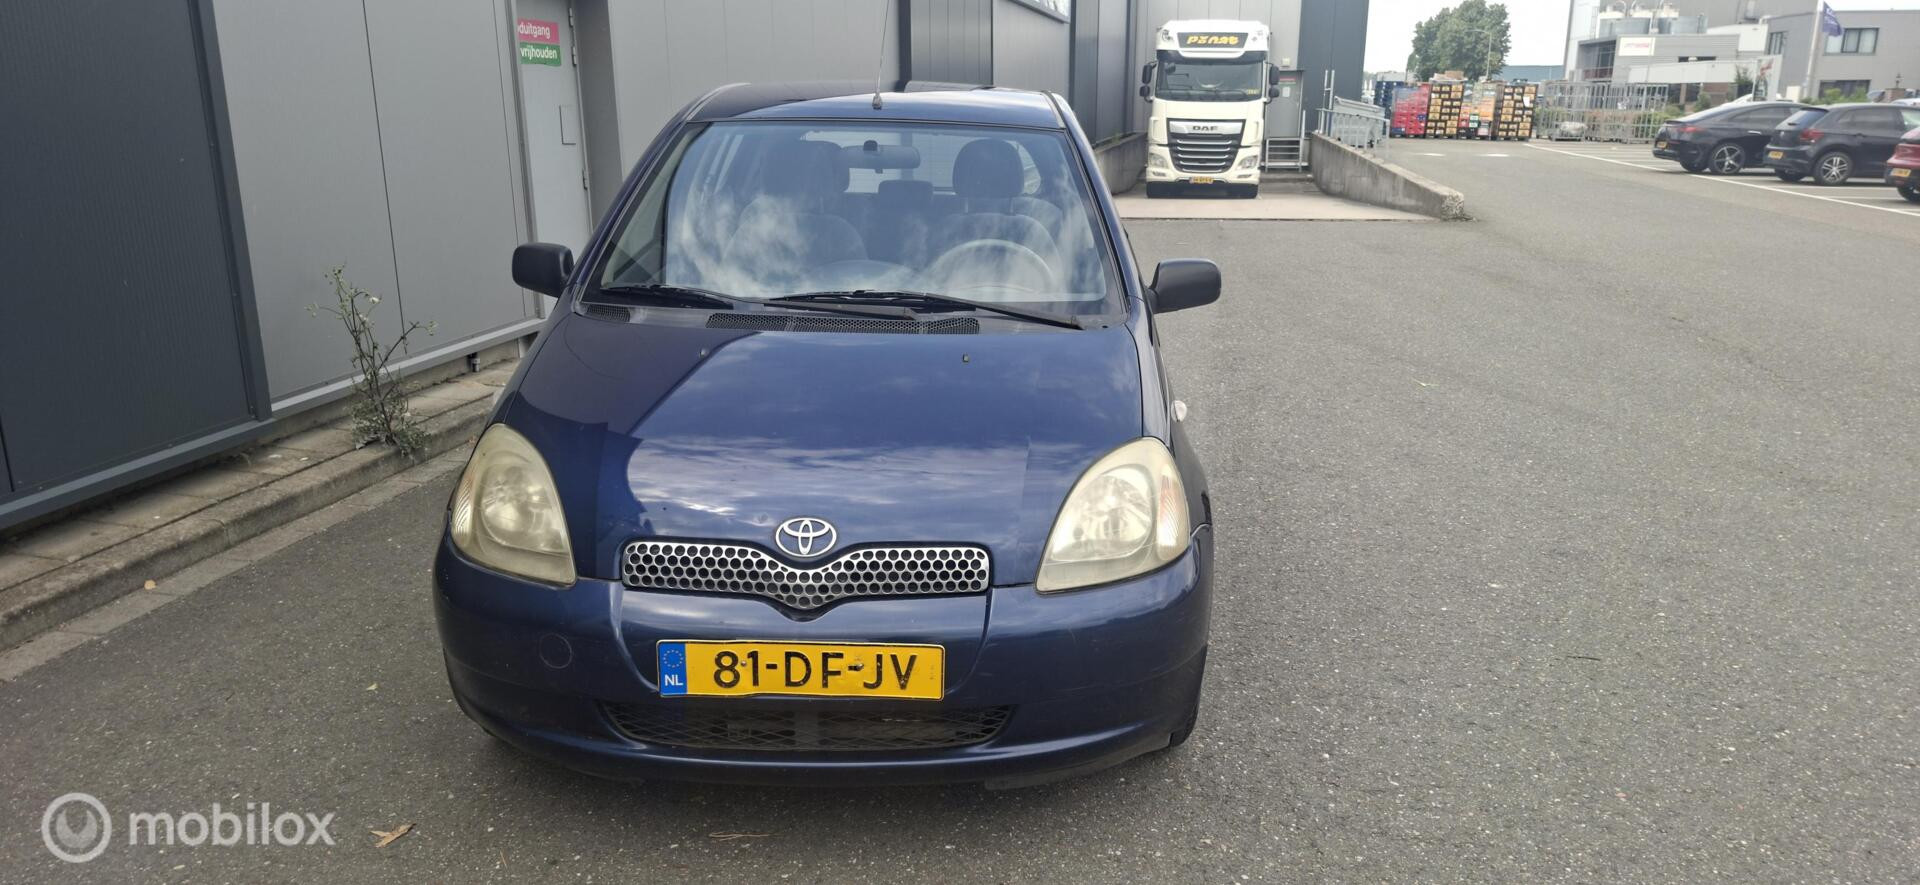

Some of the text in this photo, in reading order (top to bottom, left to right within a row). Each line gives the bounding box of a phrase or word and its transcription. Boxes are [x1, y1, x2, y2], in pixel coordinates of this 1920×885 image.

[520, 45, 557, 60] vrijhouden
[713, 650, 917, 690] 81-DF-JV
[664, 674, 683, 686] NL
